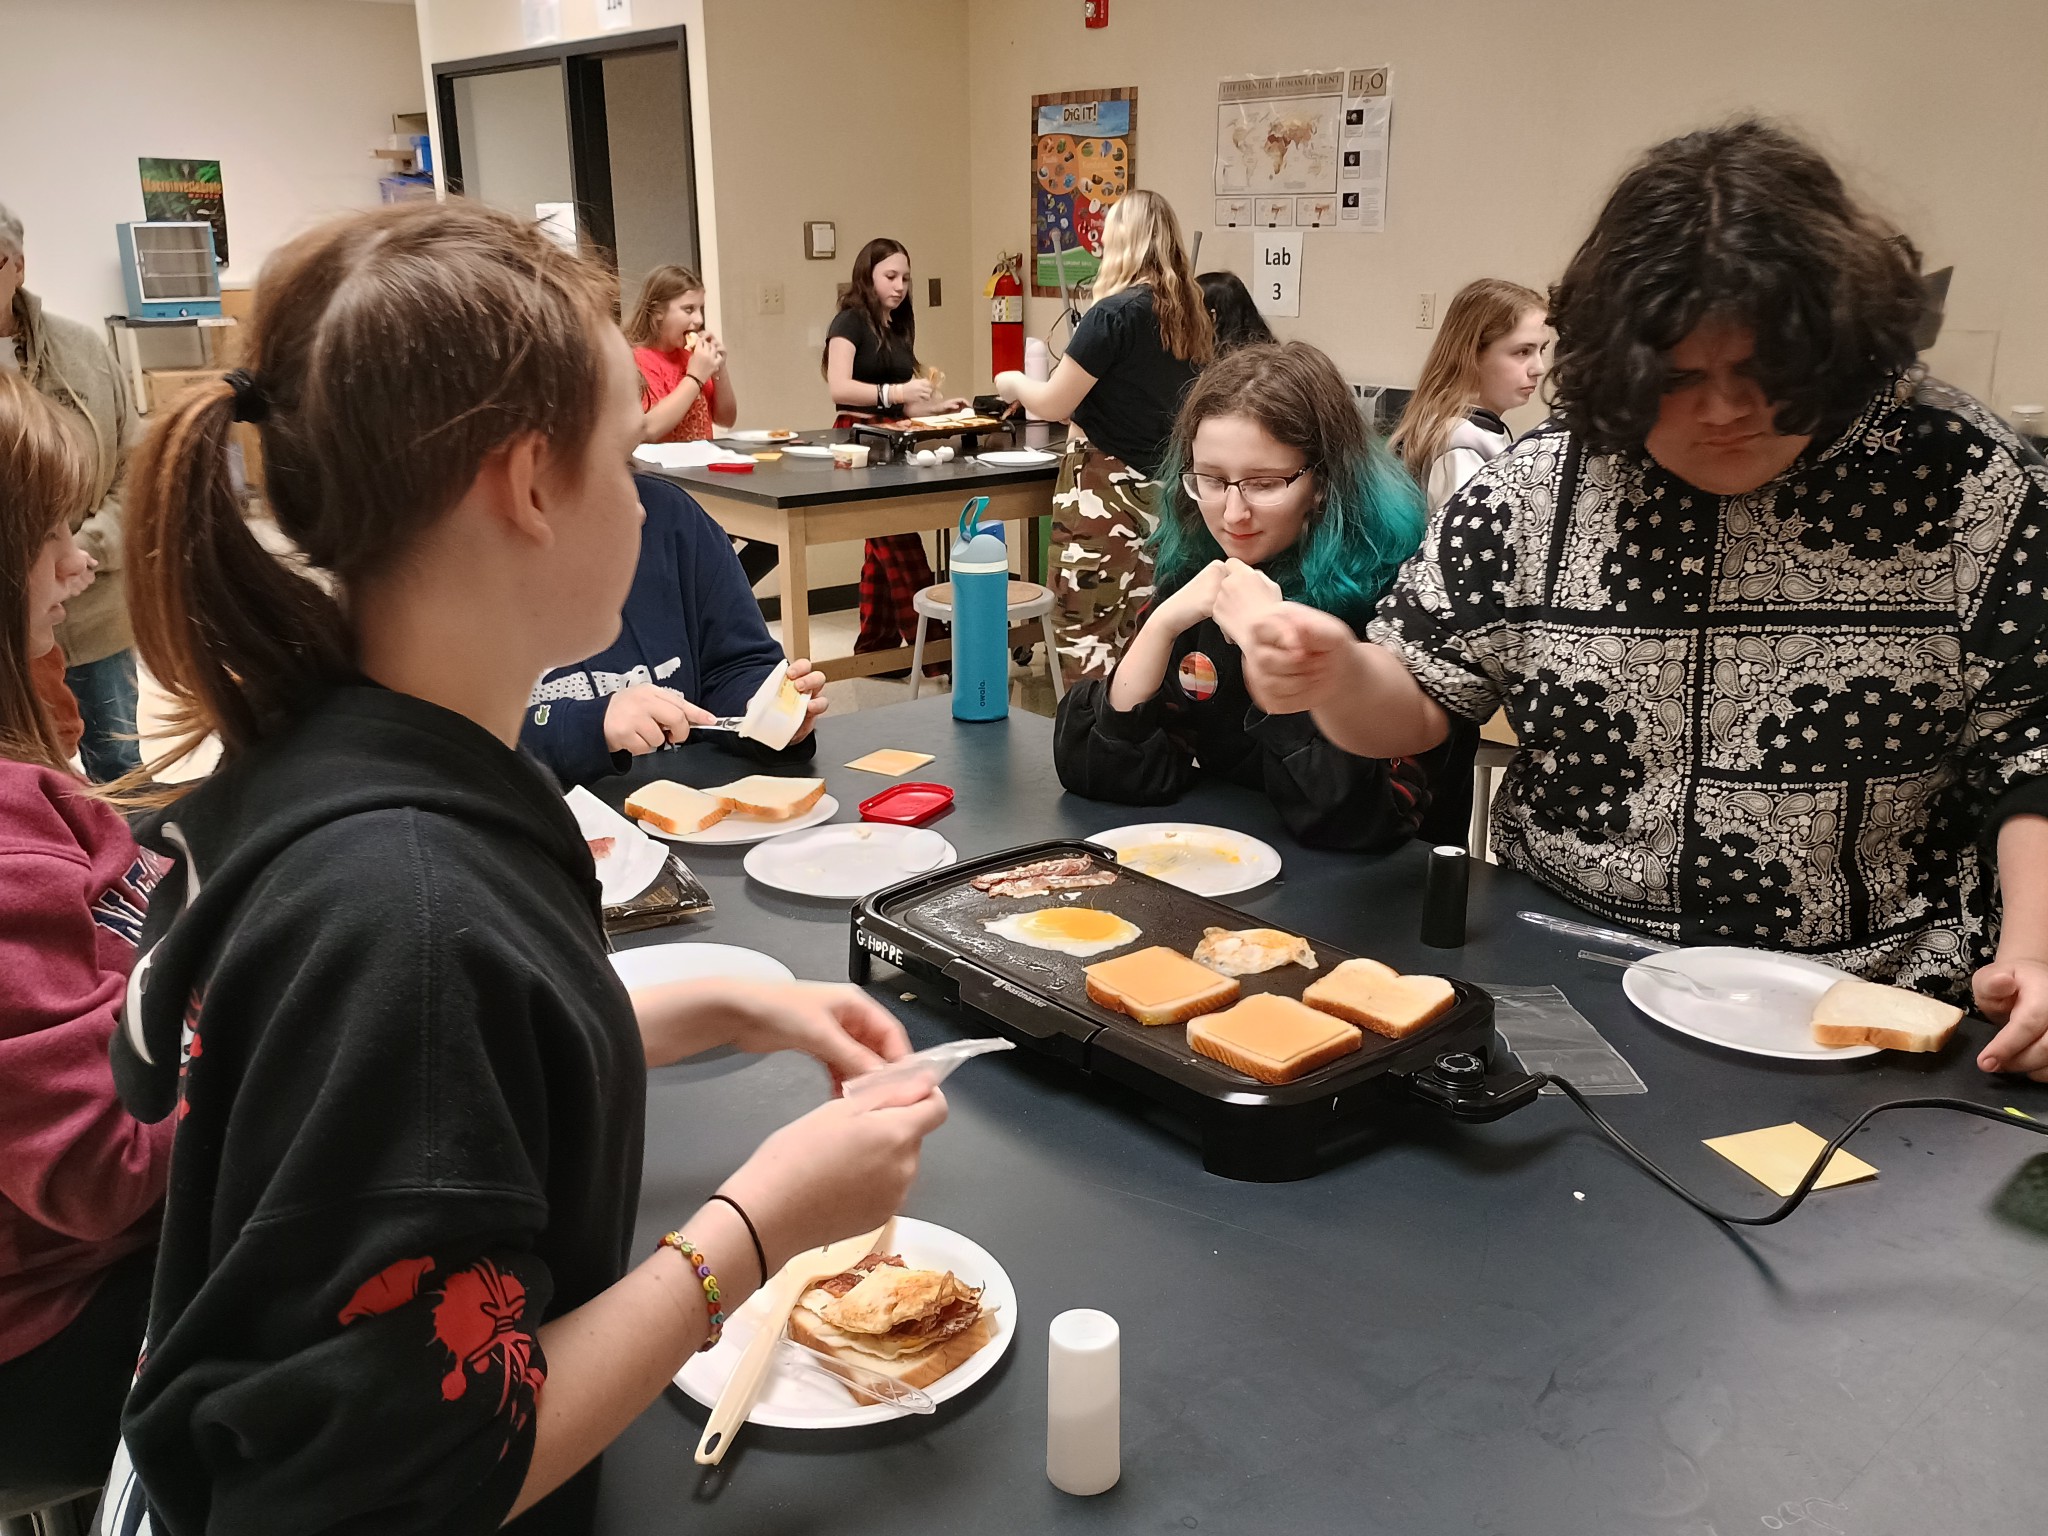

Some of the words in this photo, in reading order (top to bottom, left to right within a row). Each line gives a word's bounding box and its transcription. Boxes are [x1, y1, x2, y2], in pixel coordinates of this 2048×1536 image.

[1265, 246, 1291, 266] Lab
[1272, 282, 1282, 301] 3
[1002, 982, 1047, 1008] Toastmaster
